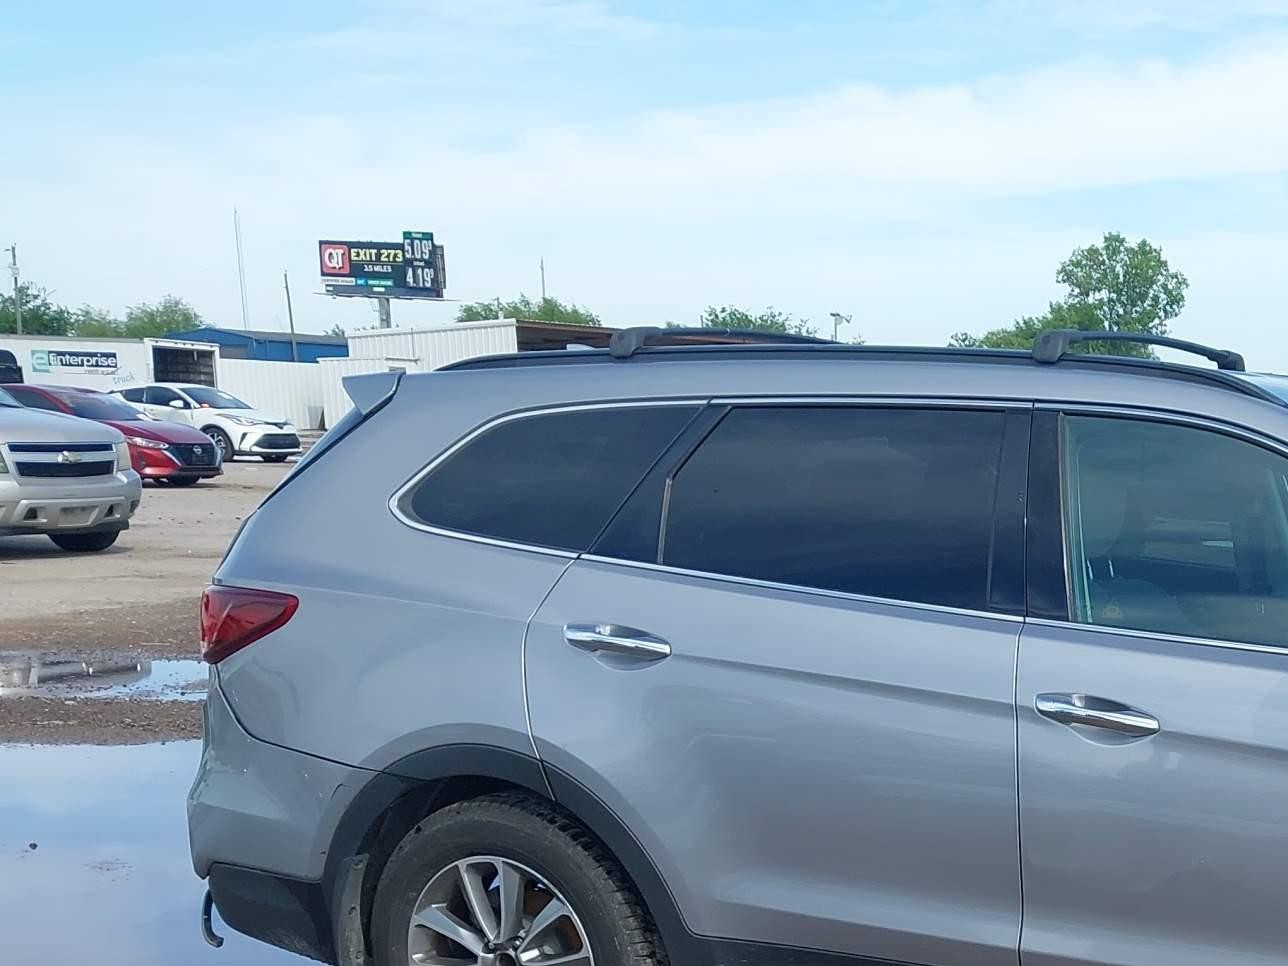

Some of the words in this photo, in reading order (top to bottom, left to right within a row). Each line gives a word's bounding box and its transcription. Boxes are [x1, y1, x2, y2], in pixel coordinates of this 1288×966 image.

[324, 248, 344, 270] QT
[351, 248, 377, 261] EXIT
[380, 249, 404, 262] 273
[49, 353, 117, 368] Enterprise
